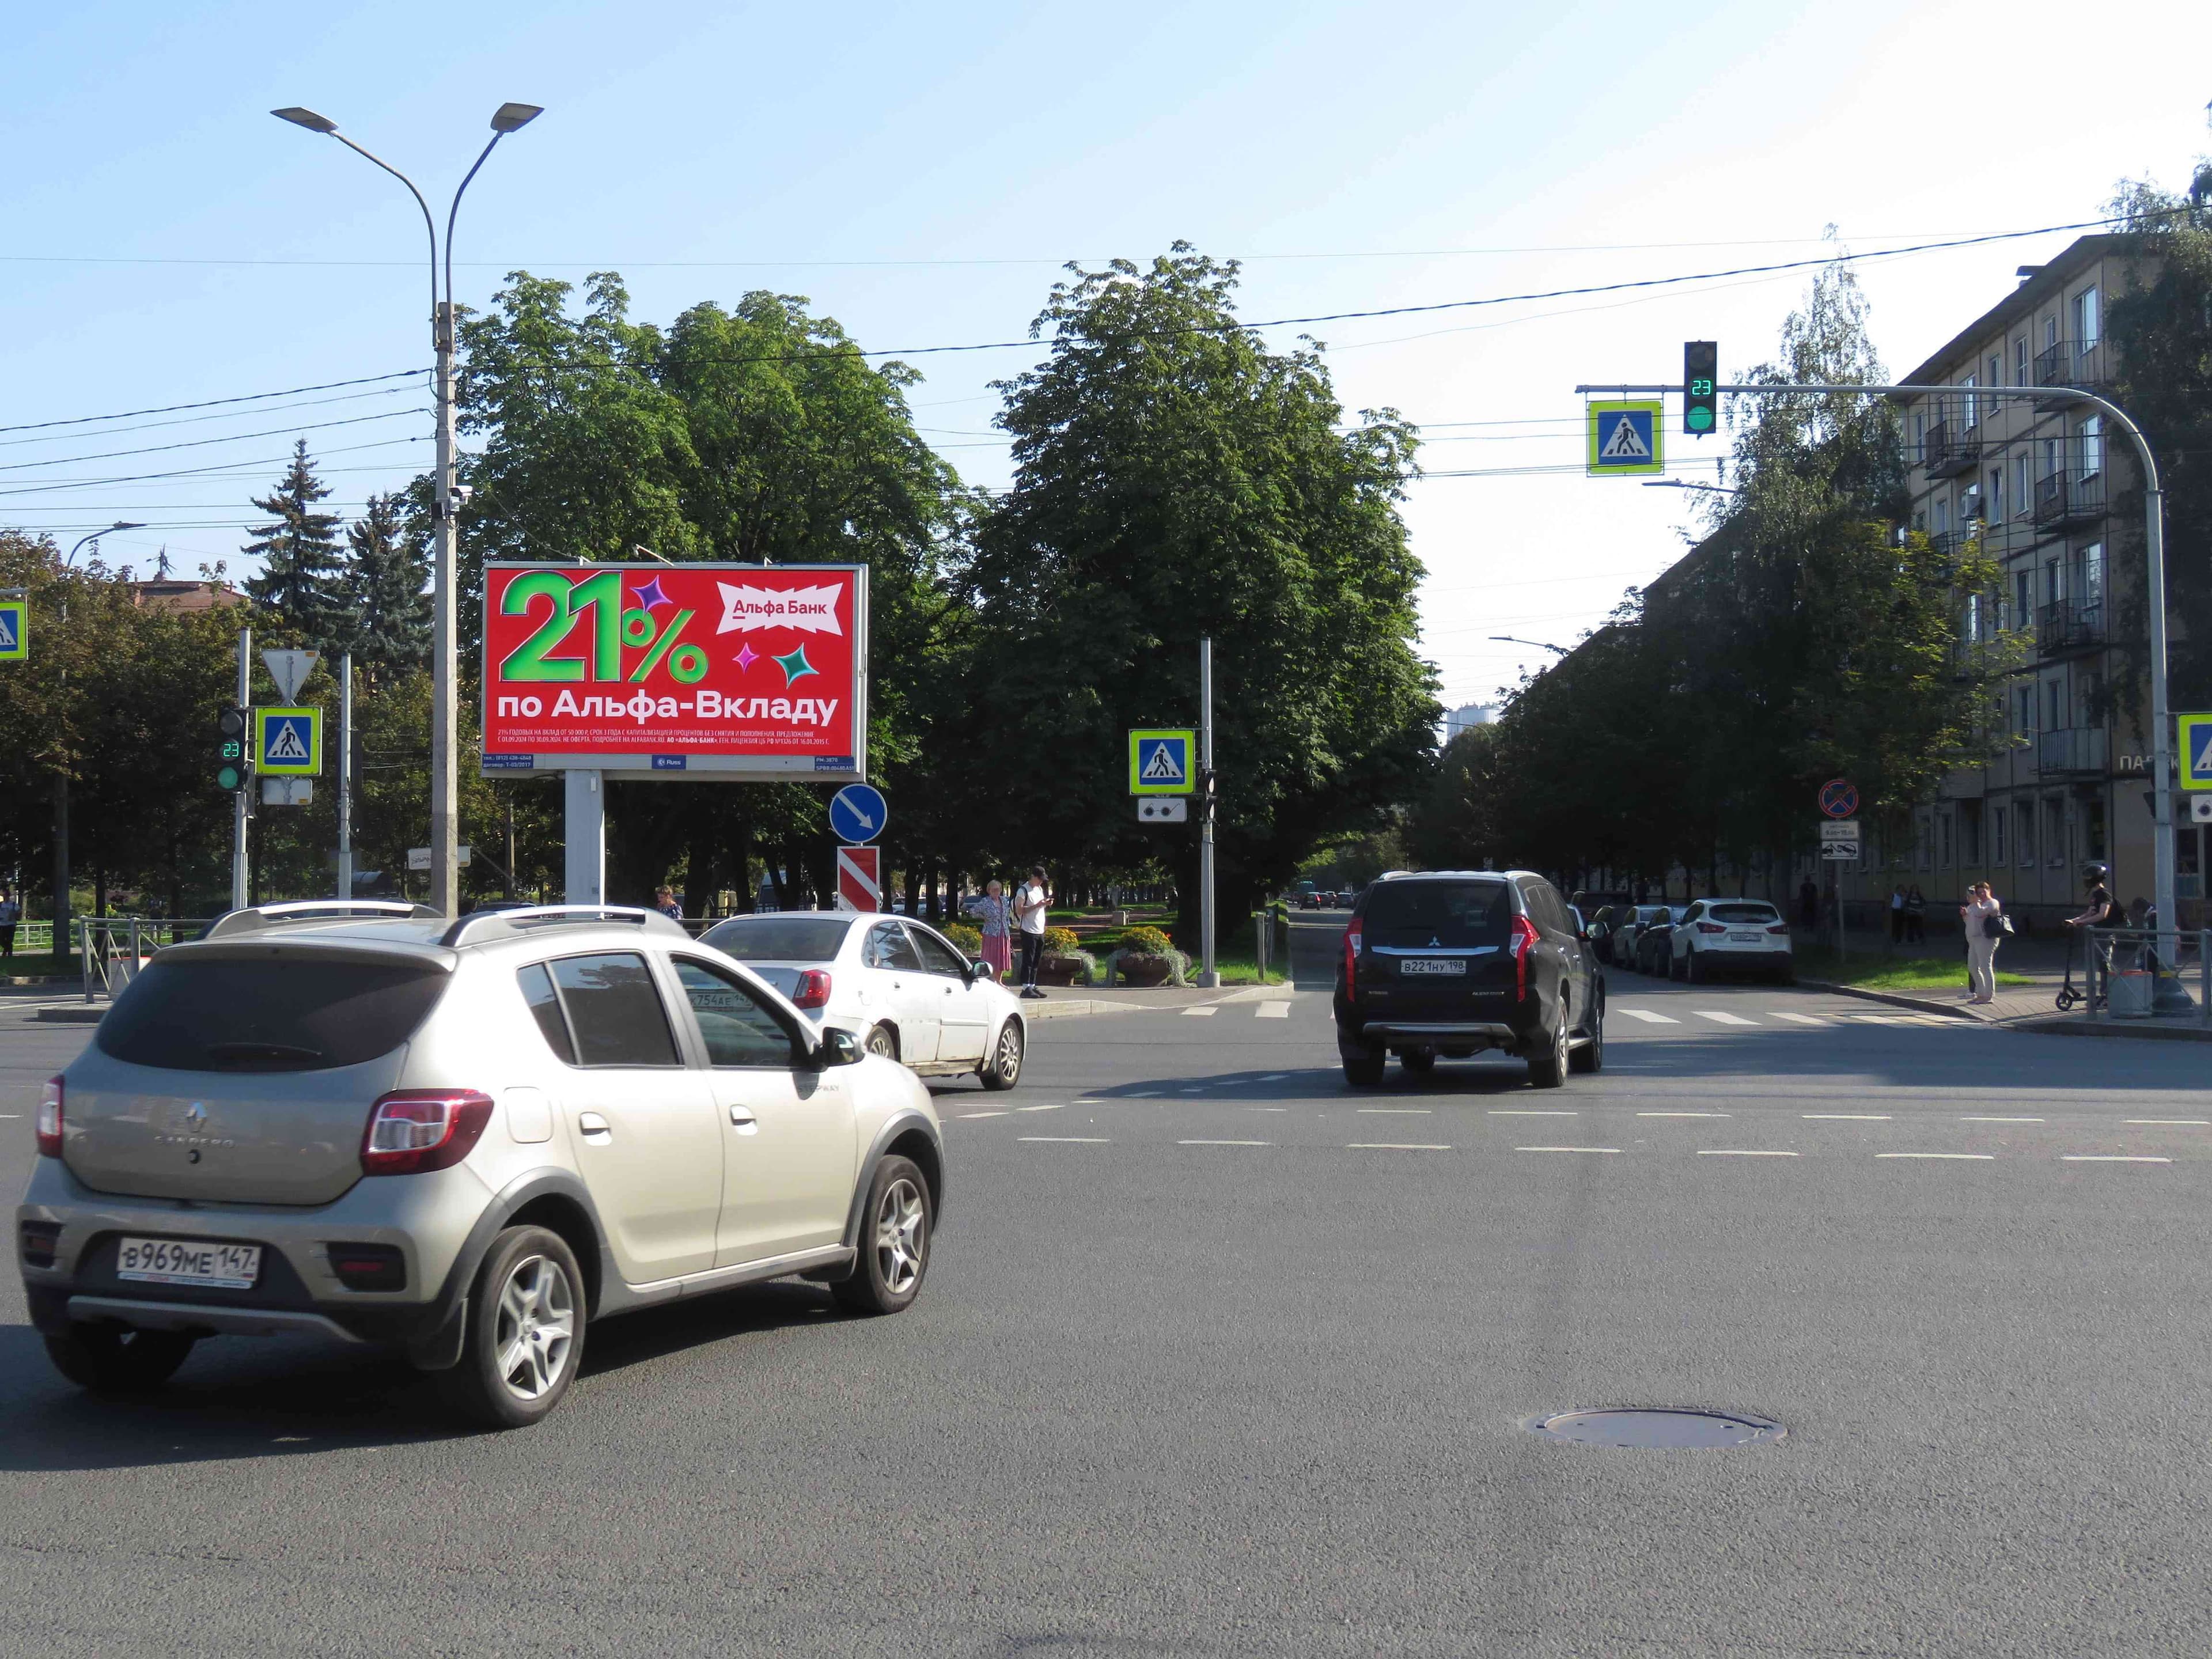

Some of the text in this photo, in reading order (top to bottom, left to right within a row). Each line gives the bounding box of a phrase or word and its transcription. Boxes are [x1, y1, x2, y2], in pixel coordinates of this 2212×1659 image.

[1692, 380, 1711, 395] 23
[733, 599, 827, 618] Альфа Банк
[499, 569, 710, 684] 21%
[498, 688, 838, 727] по Альфа-Вкладу
[626, 729, 673, 737] КАПИТАЛИЗАЦИЕЙ
[224, 743, 239, 757] 23
[2120, 755, 2179, 770] ПАРК
[1404, 961, 1463, 972] В221НУ 198
[125, 1243, 254, 1274] В969МЕ 147
